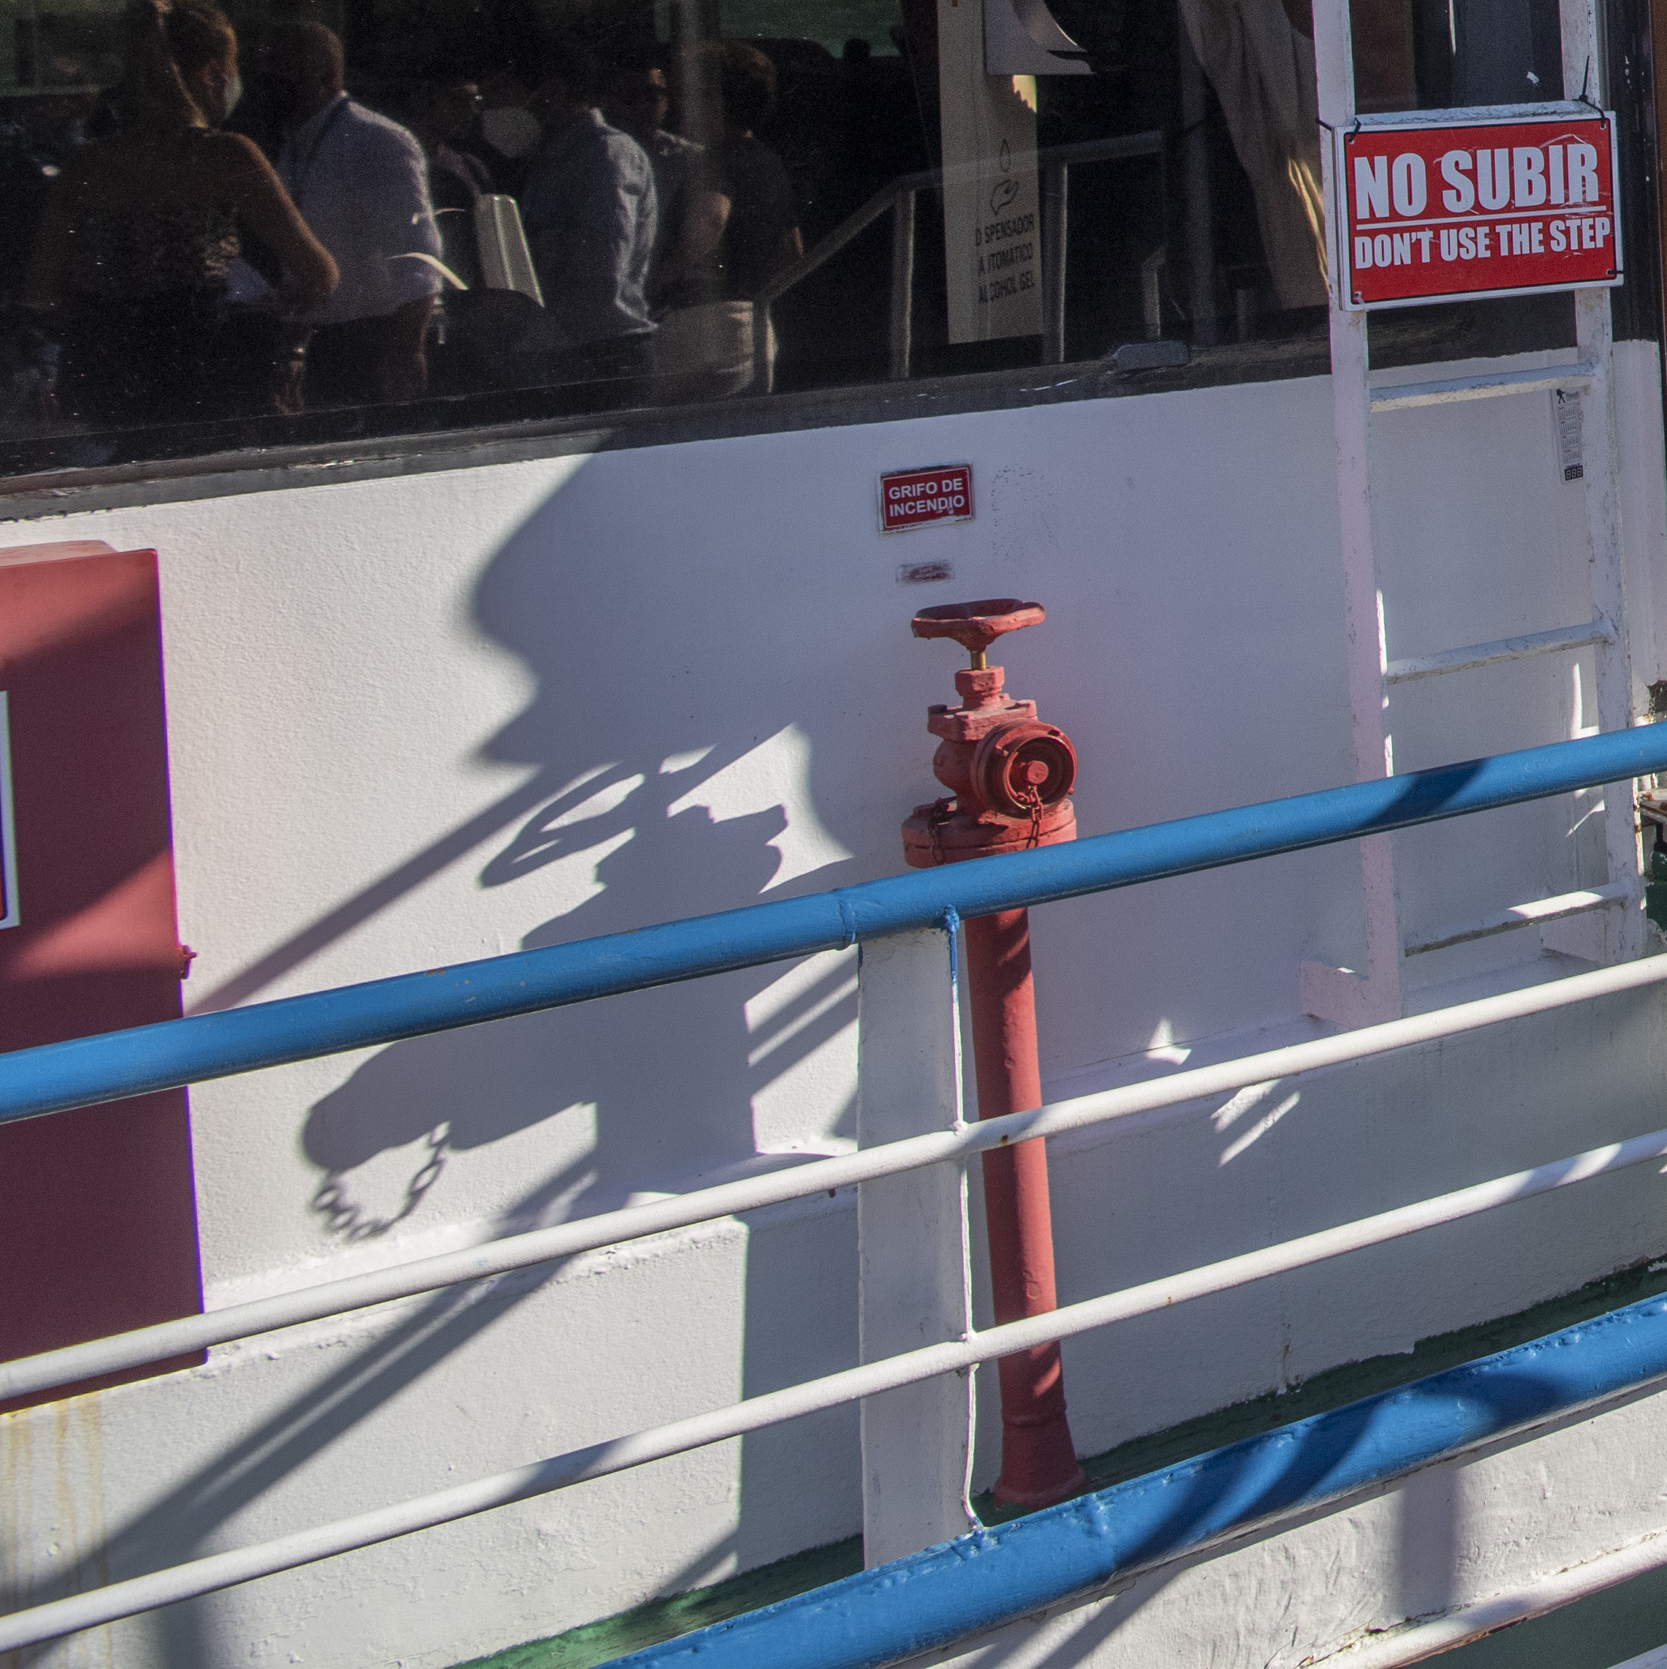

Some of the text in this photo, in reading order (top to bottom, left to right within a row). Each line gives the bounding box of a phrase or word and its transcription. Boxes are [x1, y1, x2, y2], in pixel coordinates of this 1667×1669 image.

[1353, 143, 1599, 219] NO SUBIR
[975, 213, 1035, 247] DSPENSADOR
[1355, 217, 1611, 269] DON'T USE THE STEP
[978, 242, 1034, 275] ATOMATICO
[888, 478, 964, 500] GRIFO DE
[889, 495, 965, 517] INCENDIO
